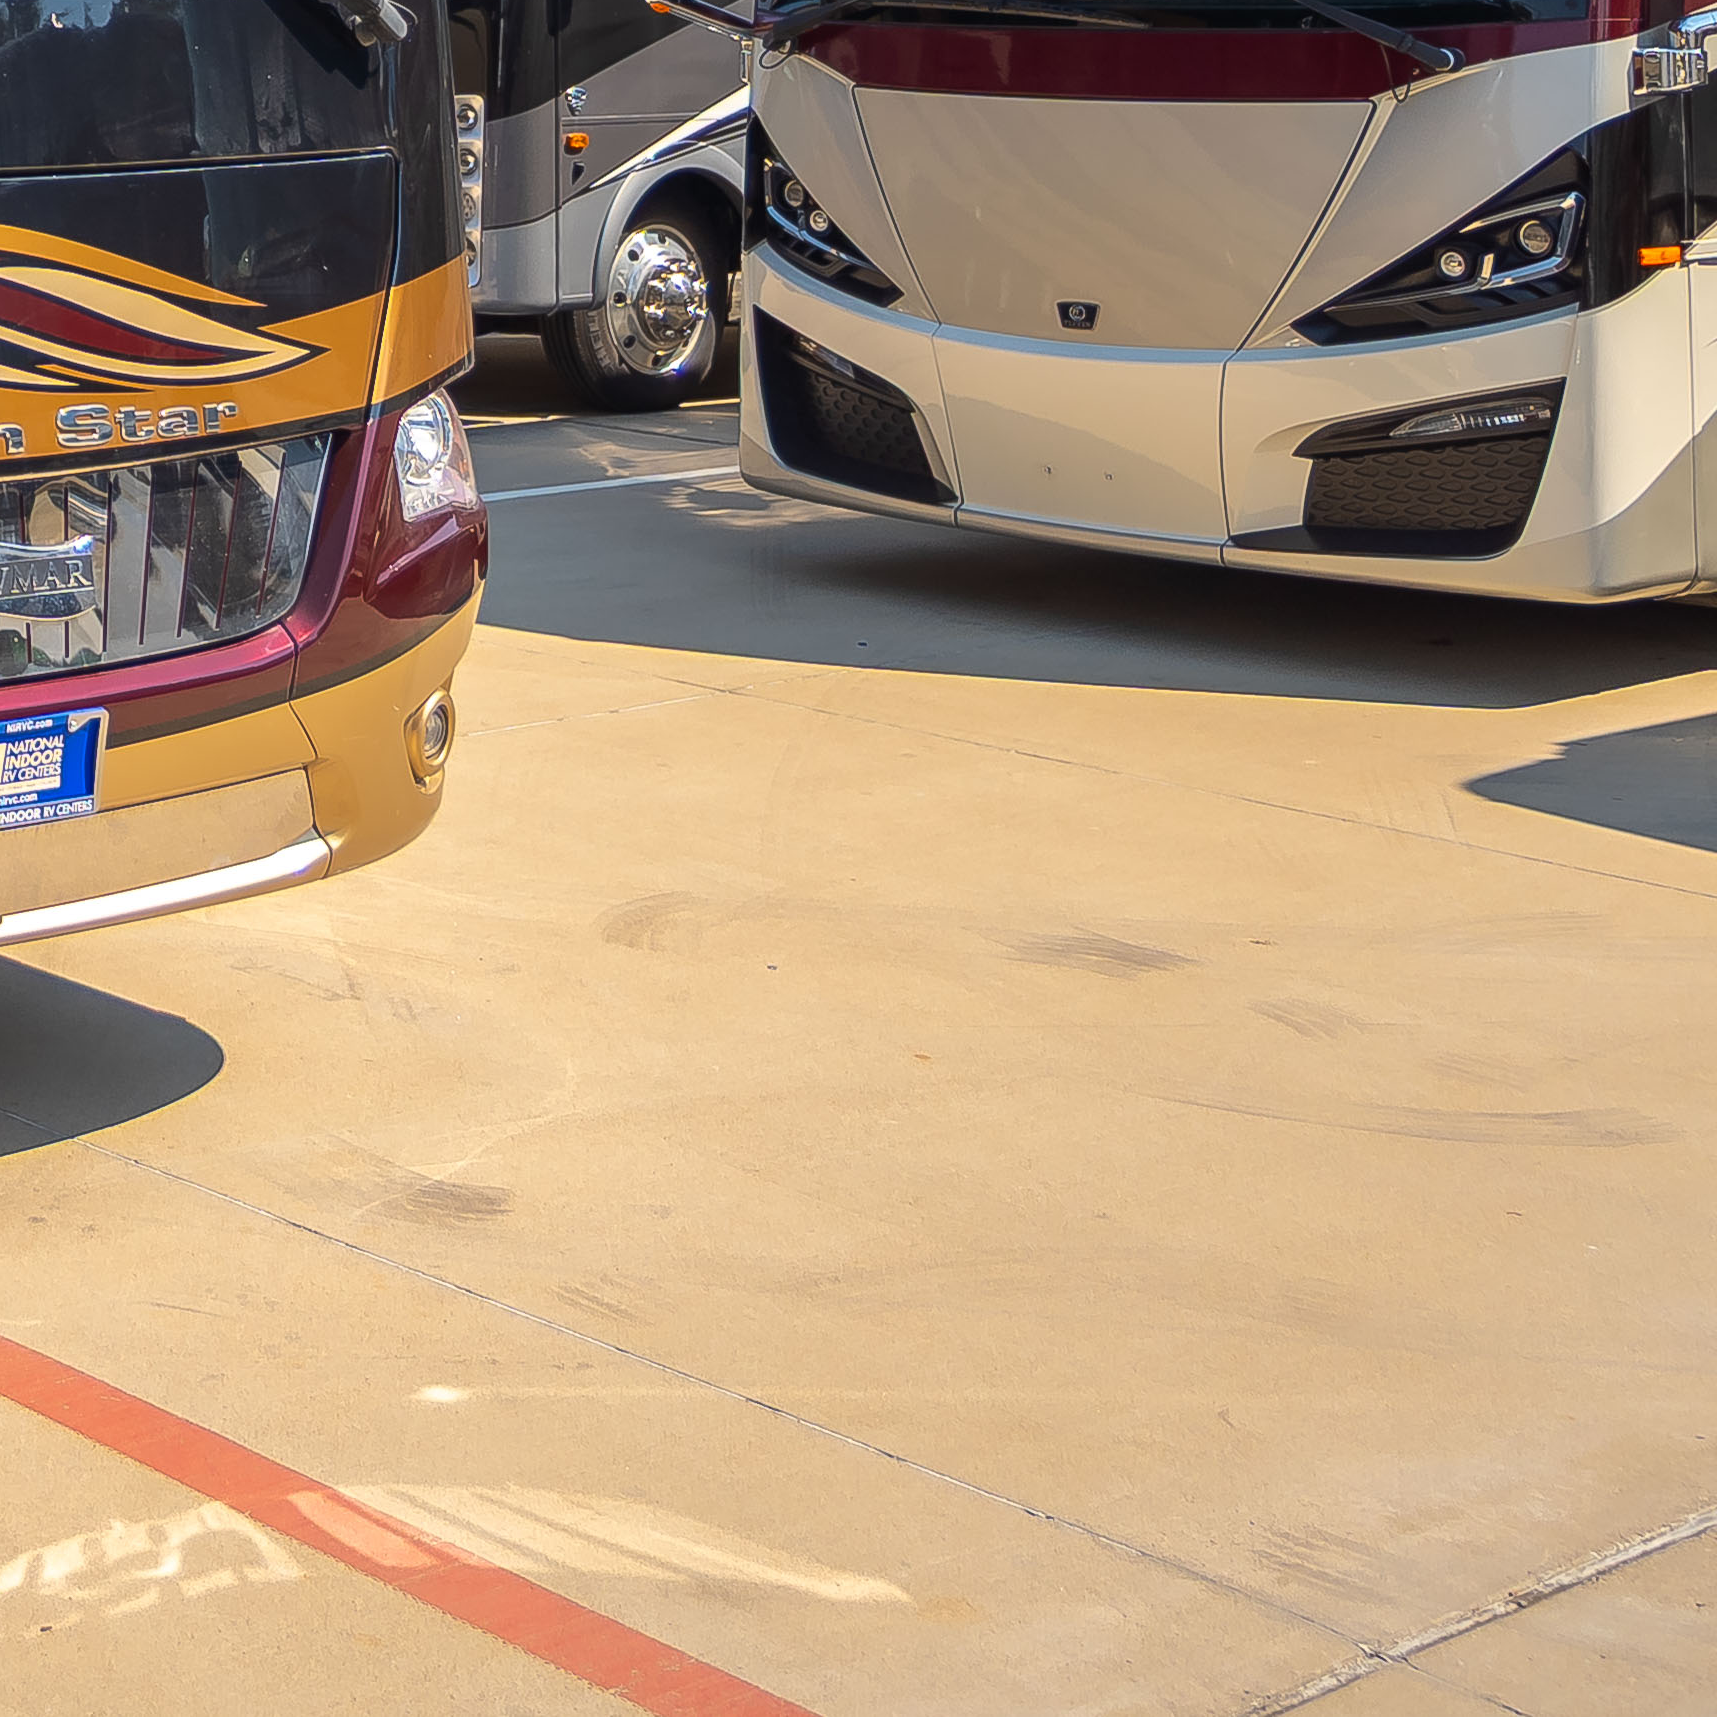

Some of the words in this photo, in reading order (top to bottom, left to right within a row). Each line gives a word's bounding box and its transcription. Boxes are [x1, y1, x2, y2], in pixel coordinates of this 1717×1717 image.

[55, 400, 238, 449] Star
[6, 734, 65, 755] NATIONAL
[4, 748, 63, 770] INDOOR
[2, 769, 17, 783] RV
[17, 762, 62, 781] CENTERS
[43, 805, 57, 818] RV
[56, 799, 94, 816] CENTERS
